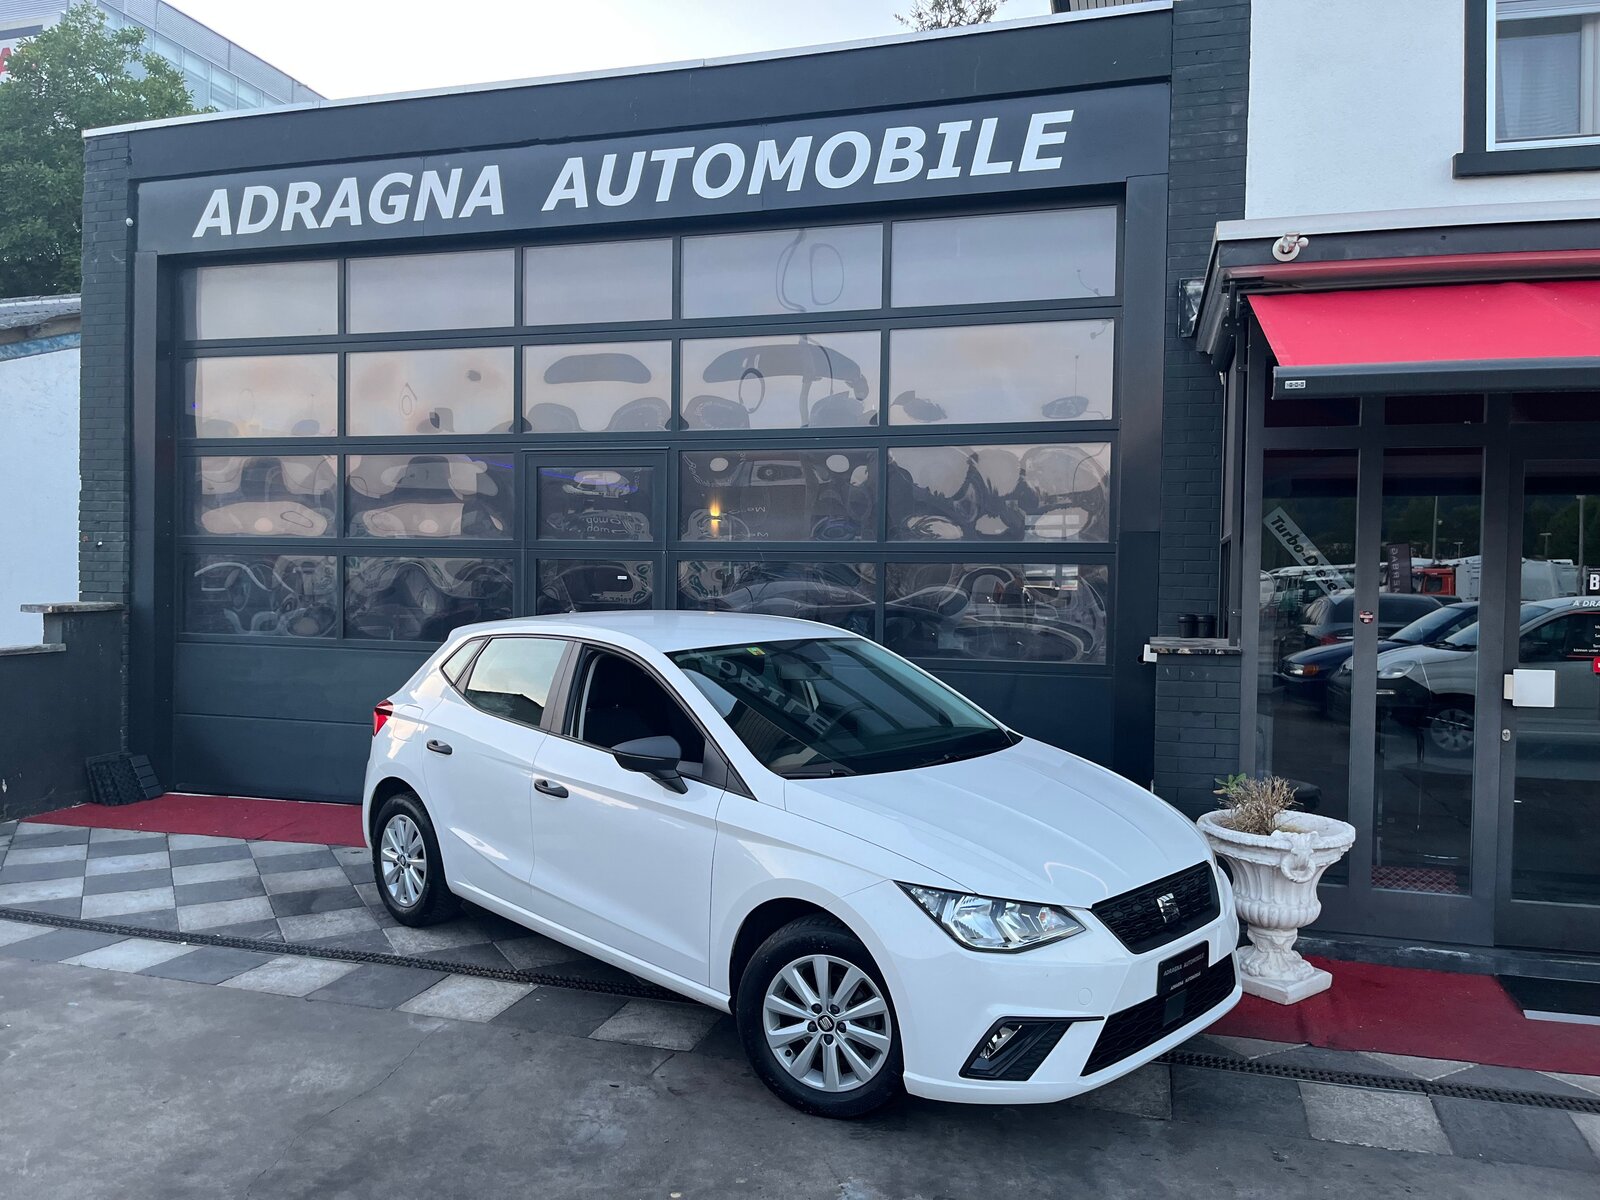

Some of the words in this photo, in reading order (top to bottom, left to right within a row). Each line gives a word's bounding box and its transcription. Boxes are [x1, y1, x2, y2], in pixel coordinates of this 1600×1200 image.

[192, 165, 504, 238] ADRAGNA
[541, 109, 1074, 211] AUTOMOBILE
[1270, 515, 1346, 596] Turbo-Dese
